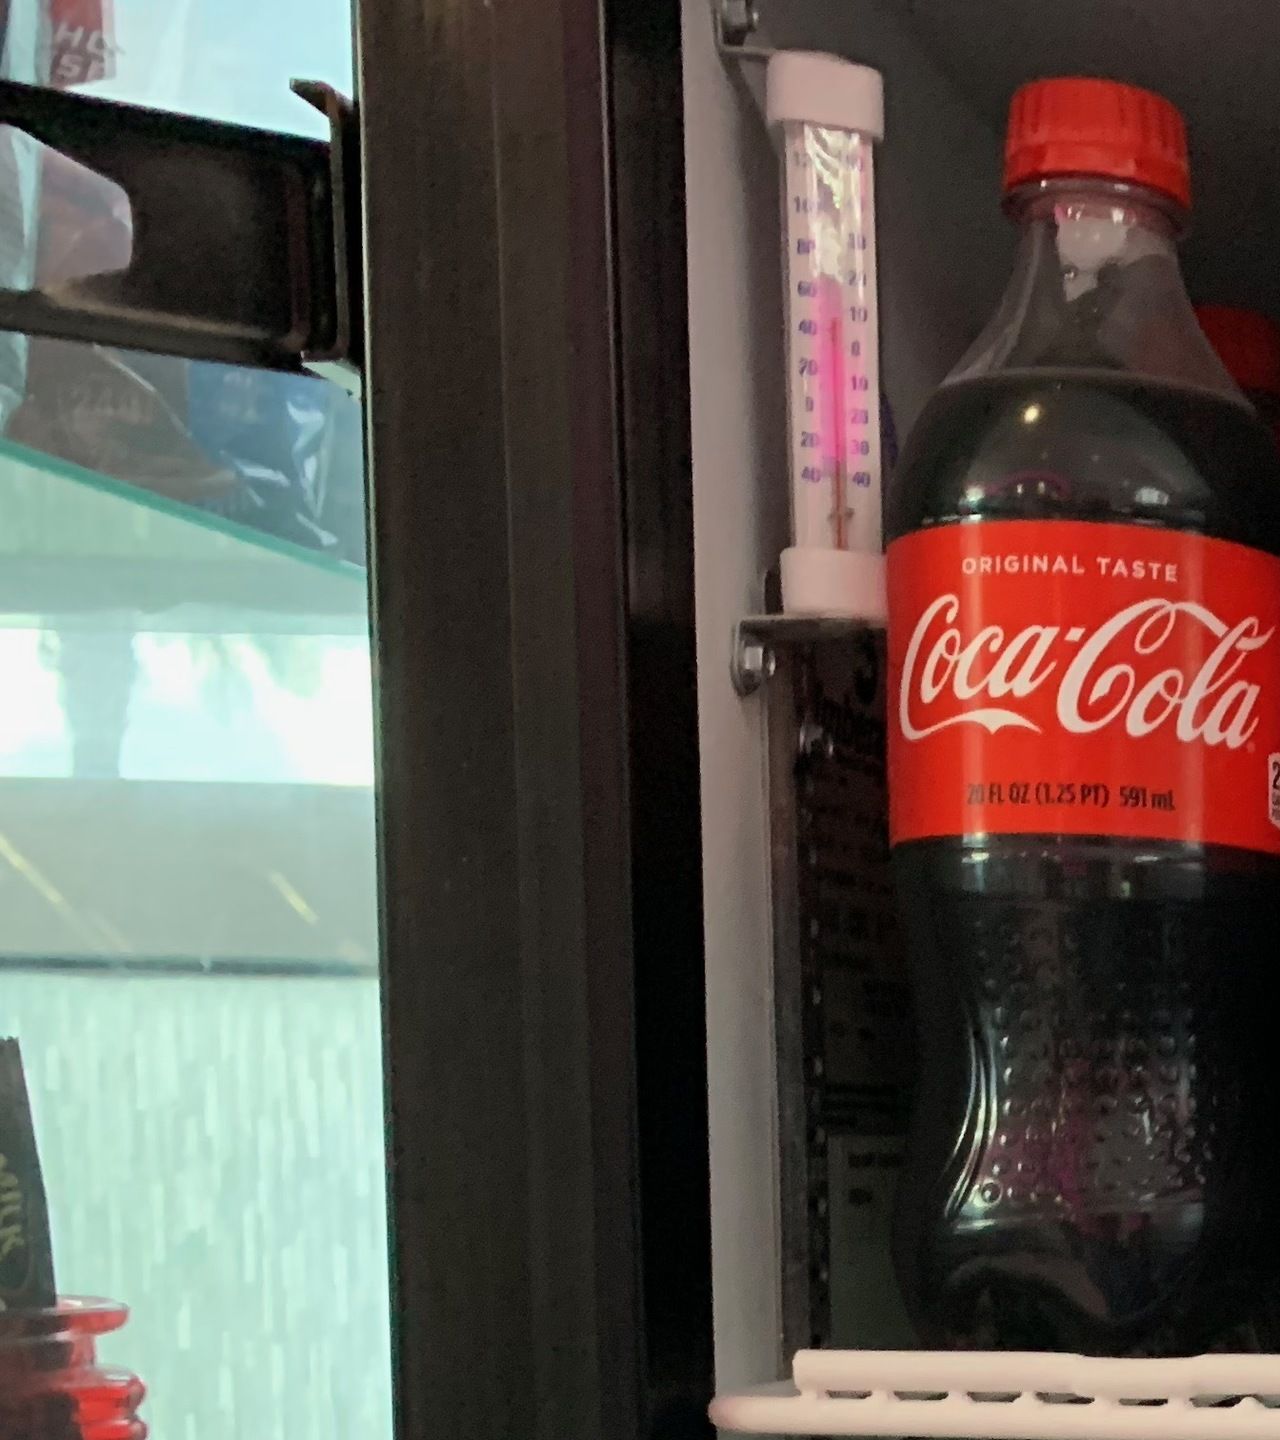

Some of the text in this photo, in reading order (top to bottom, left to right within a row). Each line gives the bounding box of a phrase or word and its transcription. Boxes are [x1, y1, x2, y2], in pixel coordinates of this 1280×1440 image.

[962, 554, 1178, 583] ORIGINAL TASTE
[900, 593, 1275, 749] Coca-Cola
[988, 785, 1003, 805] FL
[1009, 783, 1029, 803] OZ
[1035, 782, 1076, 805] (1.25
[1080, 783, 1110, 808] PT)
[1119, 786, 1147, 809] 591
